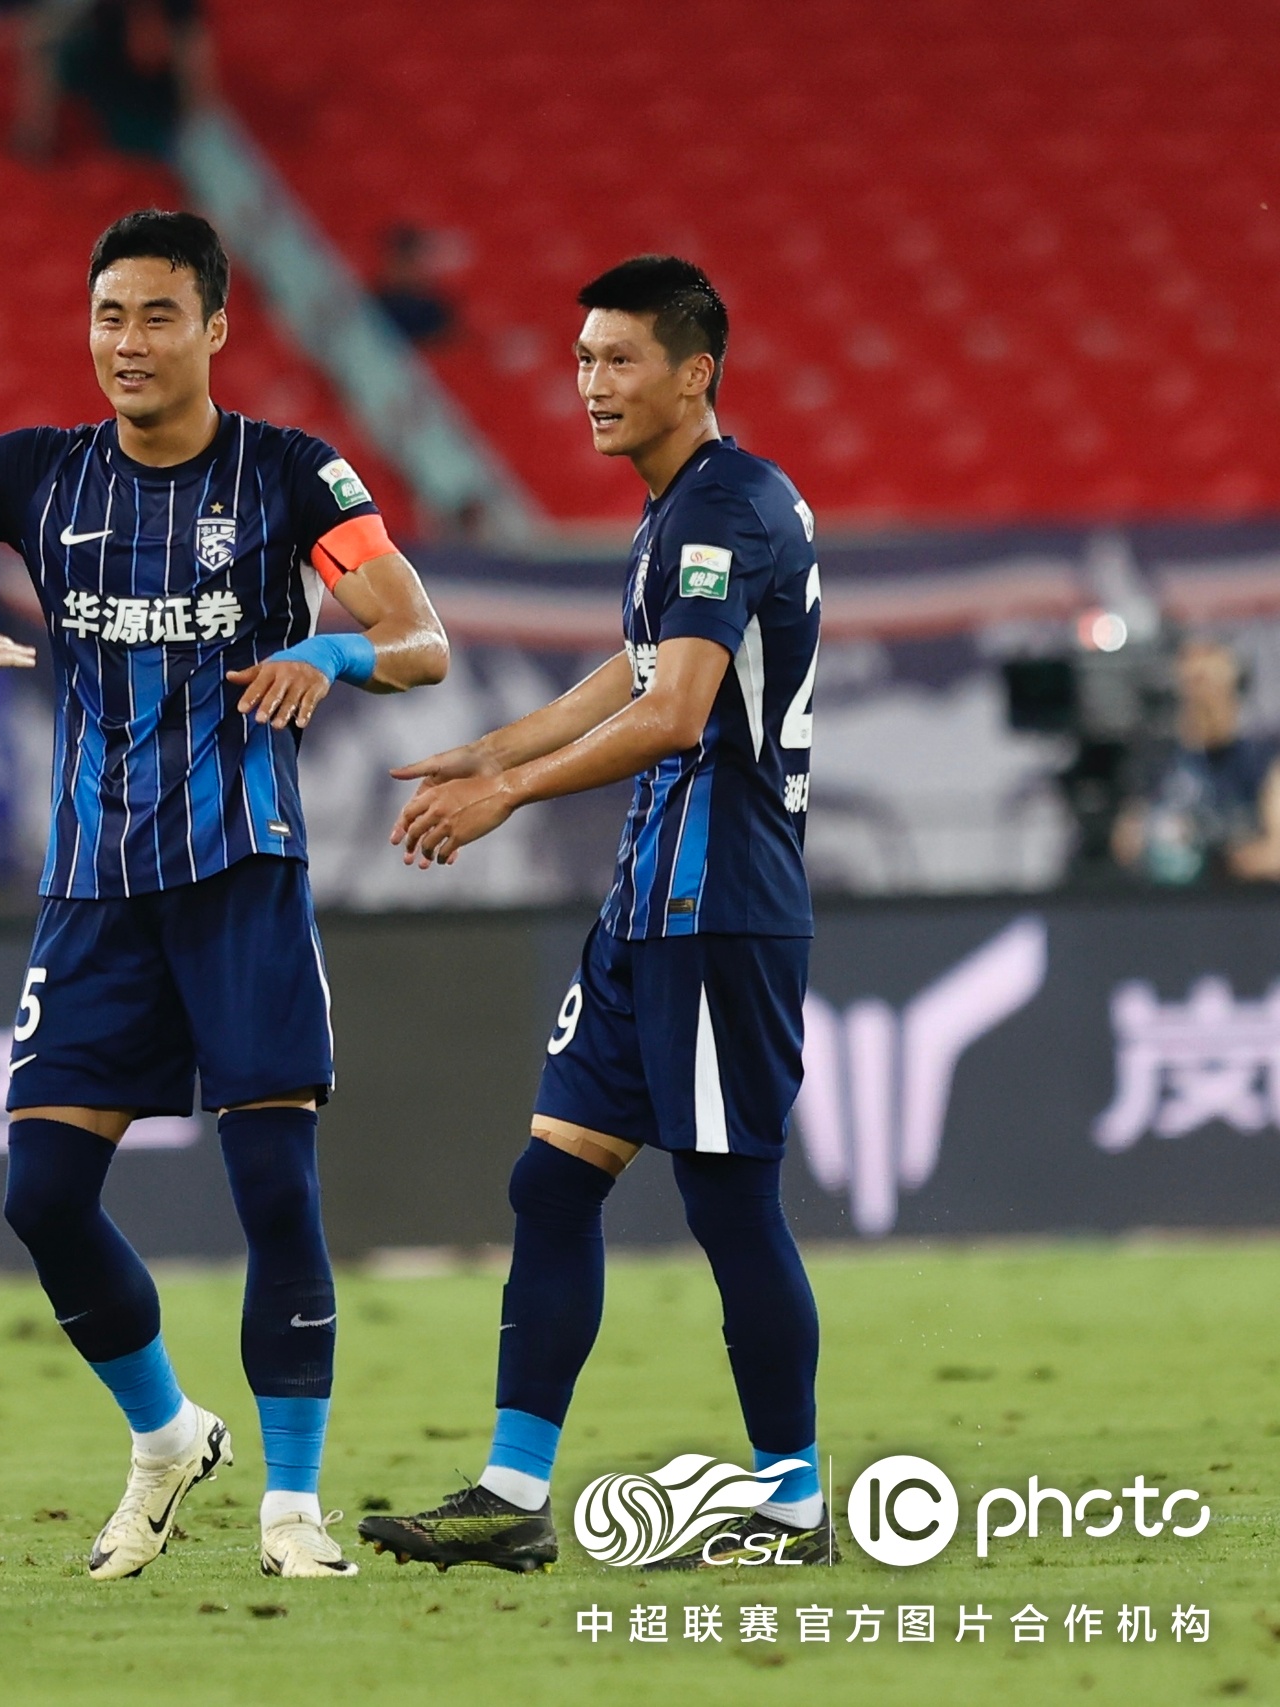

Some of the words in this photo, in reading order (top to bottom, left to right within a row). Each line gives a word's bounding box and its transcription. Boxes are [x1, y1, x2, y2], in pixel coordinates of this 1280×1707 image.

[61, 589, 244, 645] 华源证券
[14, 967, 47, 1042] 5
[547, 983, 583, 1056] 9
